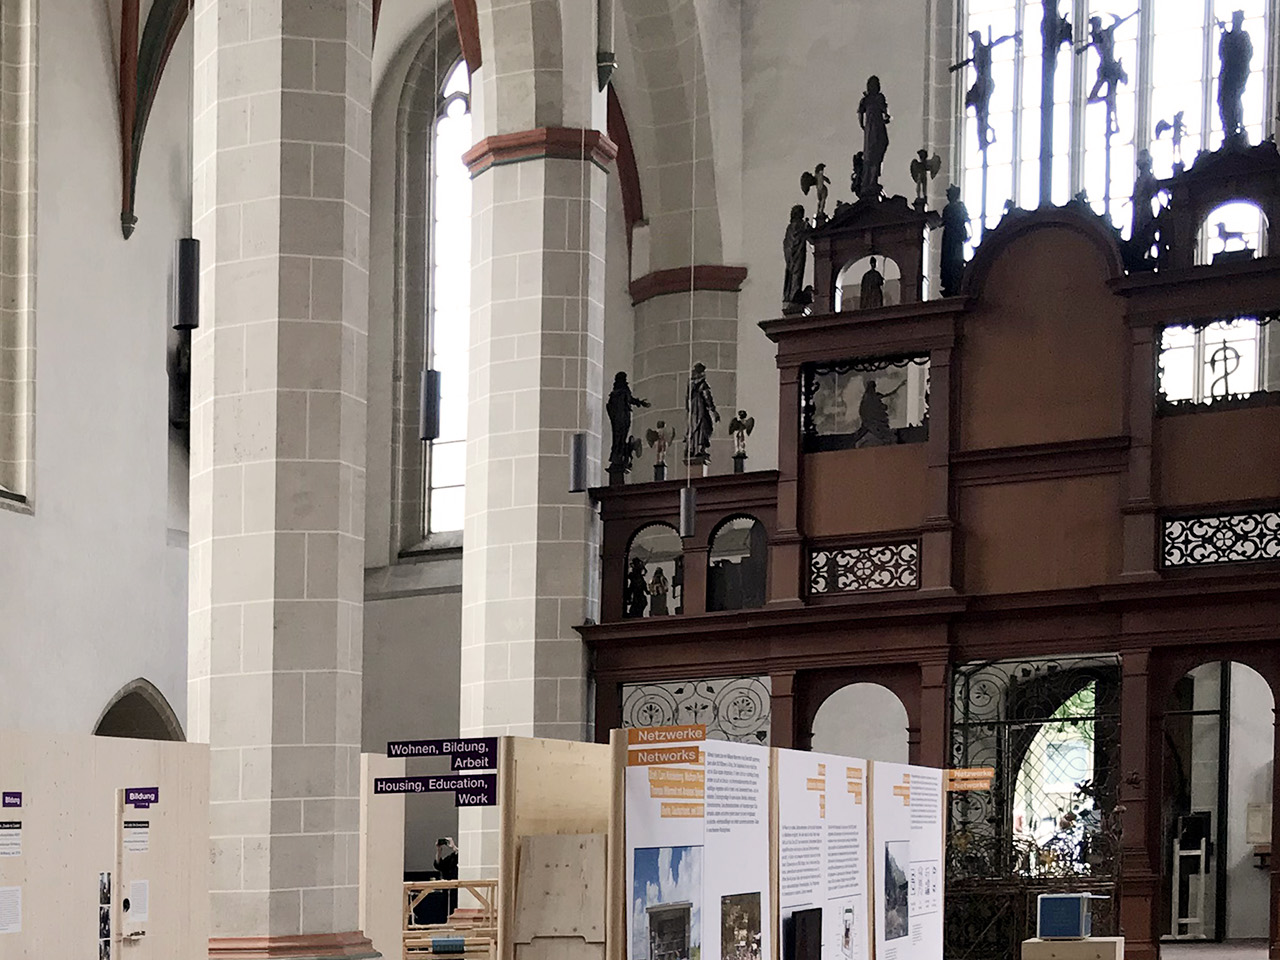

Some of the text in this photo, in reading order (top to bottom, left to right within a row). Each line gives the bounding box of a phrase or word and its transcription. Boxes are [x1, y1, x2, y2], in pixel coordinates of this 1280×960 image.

[638, 728, 703, 741] Netzwerke
[390, 742, 489, 756] Wohnen, Bildung,
[454, 756, 489, 768] Arbeit
[638, 750, 696, 763] Networks
[377, 778, 488, 793] Housing, Education,
[129, 792, 155, 801] Bildung
[458, 793, 488, 804] Work
